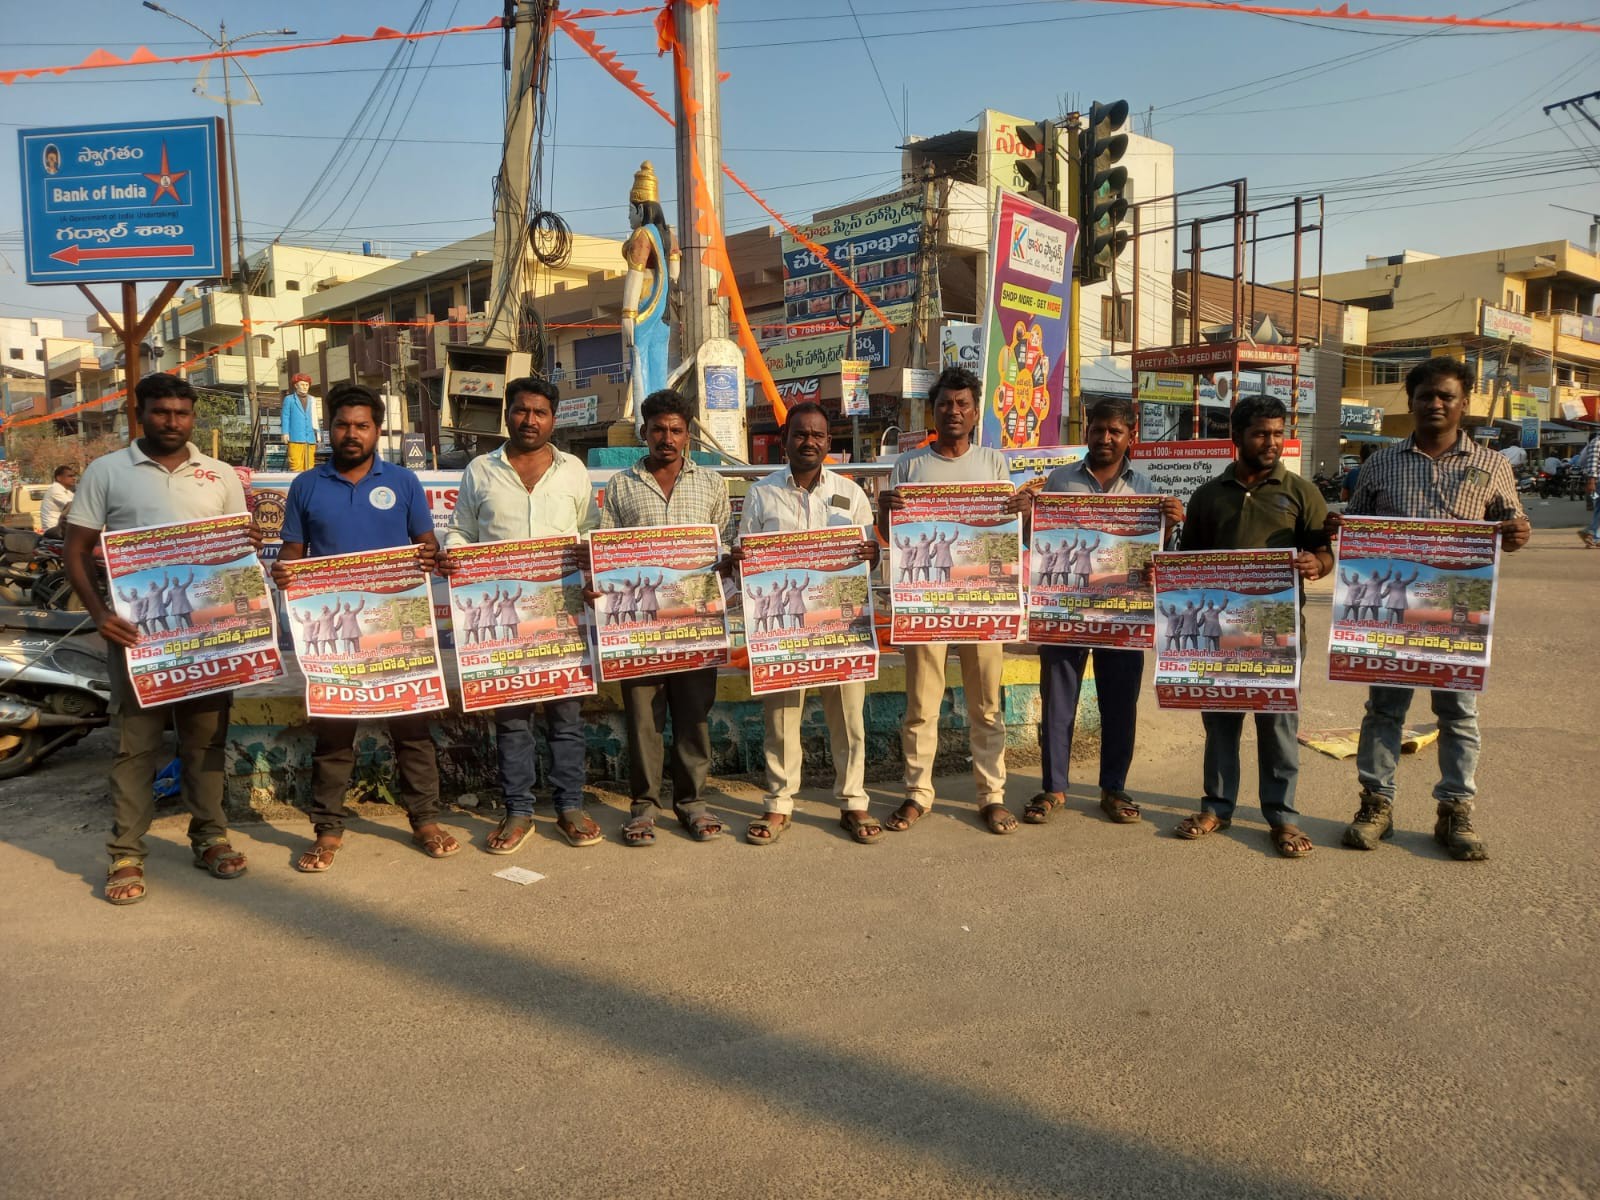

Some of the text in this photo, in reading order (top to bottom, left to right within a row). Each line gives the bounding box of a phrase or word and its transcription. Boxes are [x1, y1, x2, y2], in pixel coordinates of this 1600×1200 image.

[78, 146, 144, 166] స్వాగతం
[53, 184, 147, 203] Bank of India
[56, 222, 184, 243] గద్వాల్ శాఖ
[1002, 289, 1018, 302] SHOP
[1018, 294, 1033, 307] MORE
[1036, 298, 1047, 310] GET
[1135, 358, 1161, 369] SAFETY
[1187, 352, 1210, 364] SPEED
[1212, 350, 1232, 361] NEXT
[1174, 448, 1184, 456] FOR
[1207, 448, 1230, 456] POSTERS
[910, 615, 1016, 628] PDSU-PYL
[1045, 620, 1151, 636] PDSU-PYL
[618, 649, 724, 668] PDSU-PYL
[768, 655, 872, 677] PDSU-PYL
[1349, 655, 1480, 677] PDSU-PYL
[152, 651, 275, 687] PDSU-PYL
[325, 679, 439, 700] PDSU-PYL
[480, 667, 589, 693] PDSU-PYL
[1173, 686, 1293, 699] PDSU-PYL
